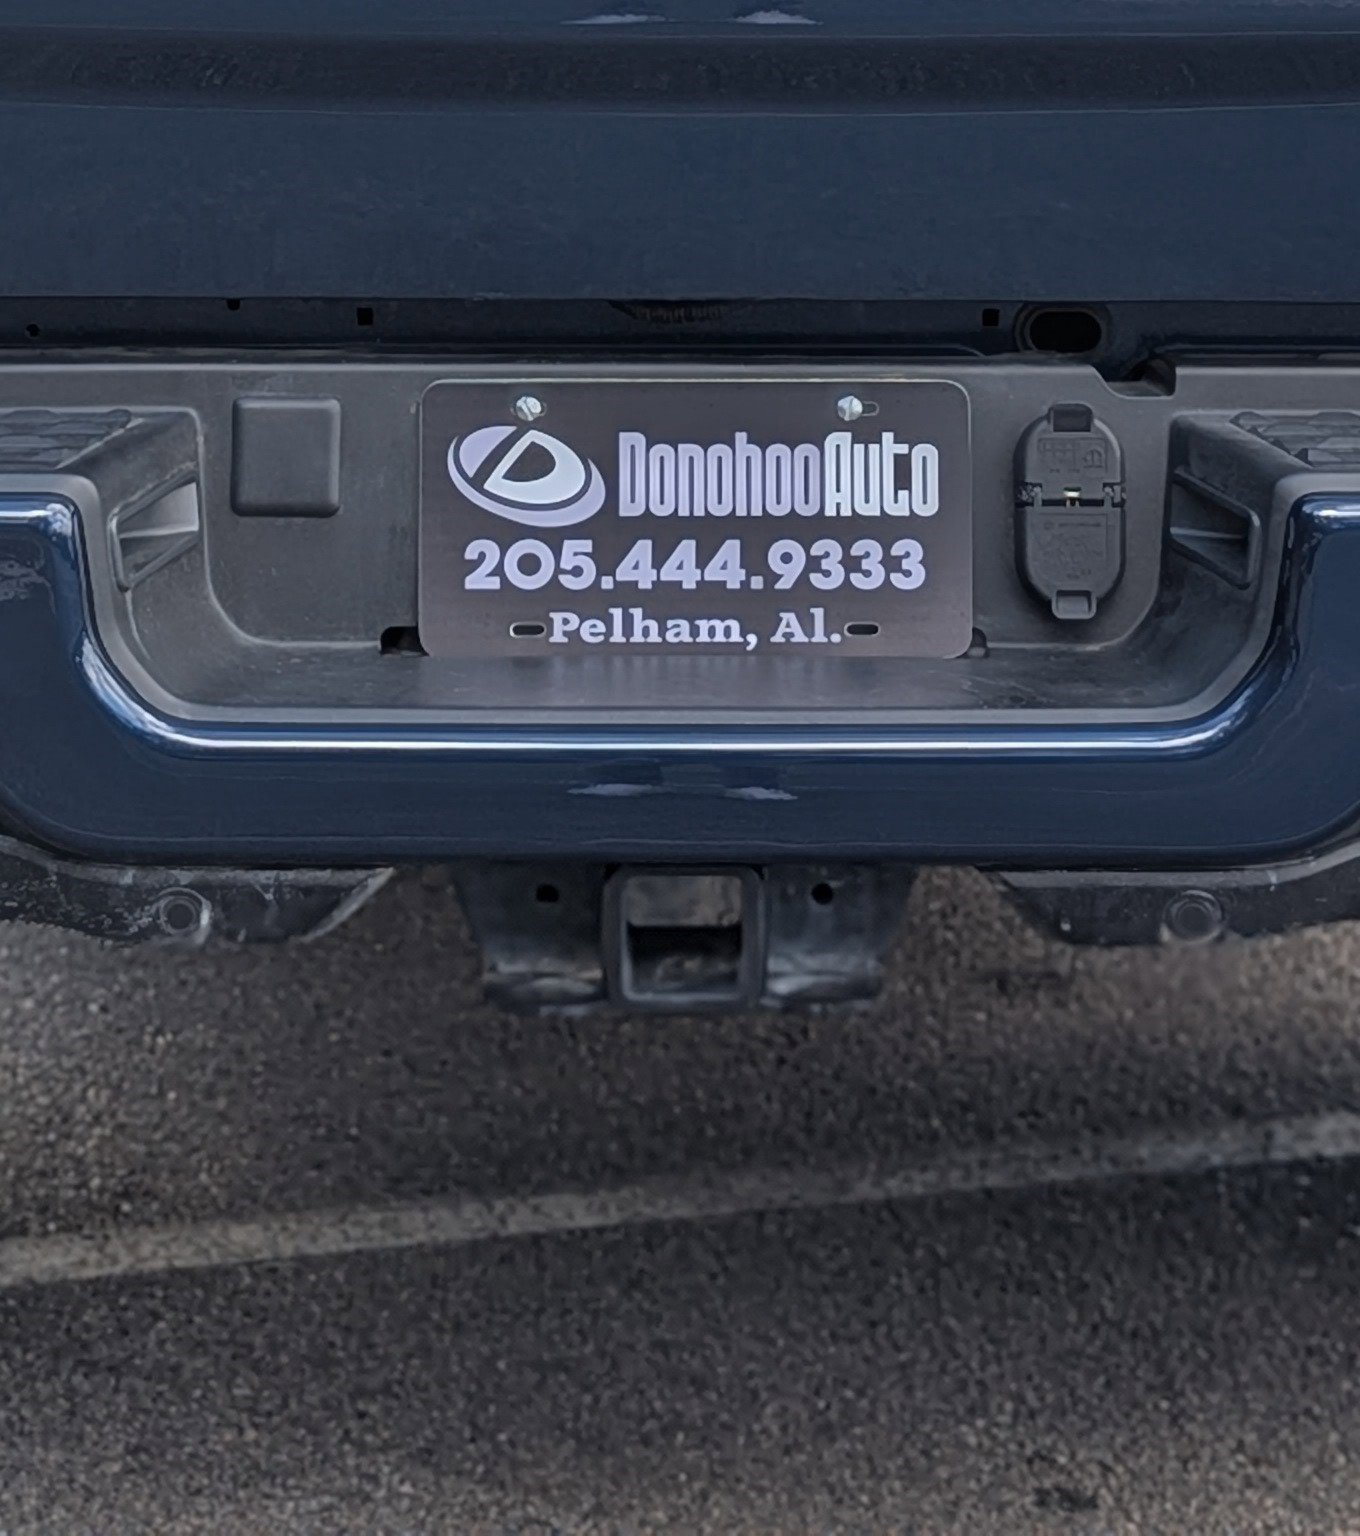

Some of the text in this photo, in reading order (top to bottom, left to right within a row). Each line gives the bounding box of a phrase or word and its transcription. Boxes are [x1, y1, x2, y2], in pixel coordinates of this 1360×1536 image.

[463, 538, 927, 591] 205.444.9333
[548, 607, 842, 651] Pelham, Al.
